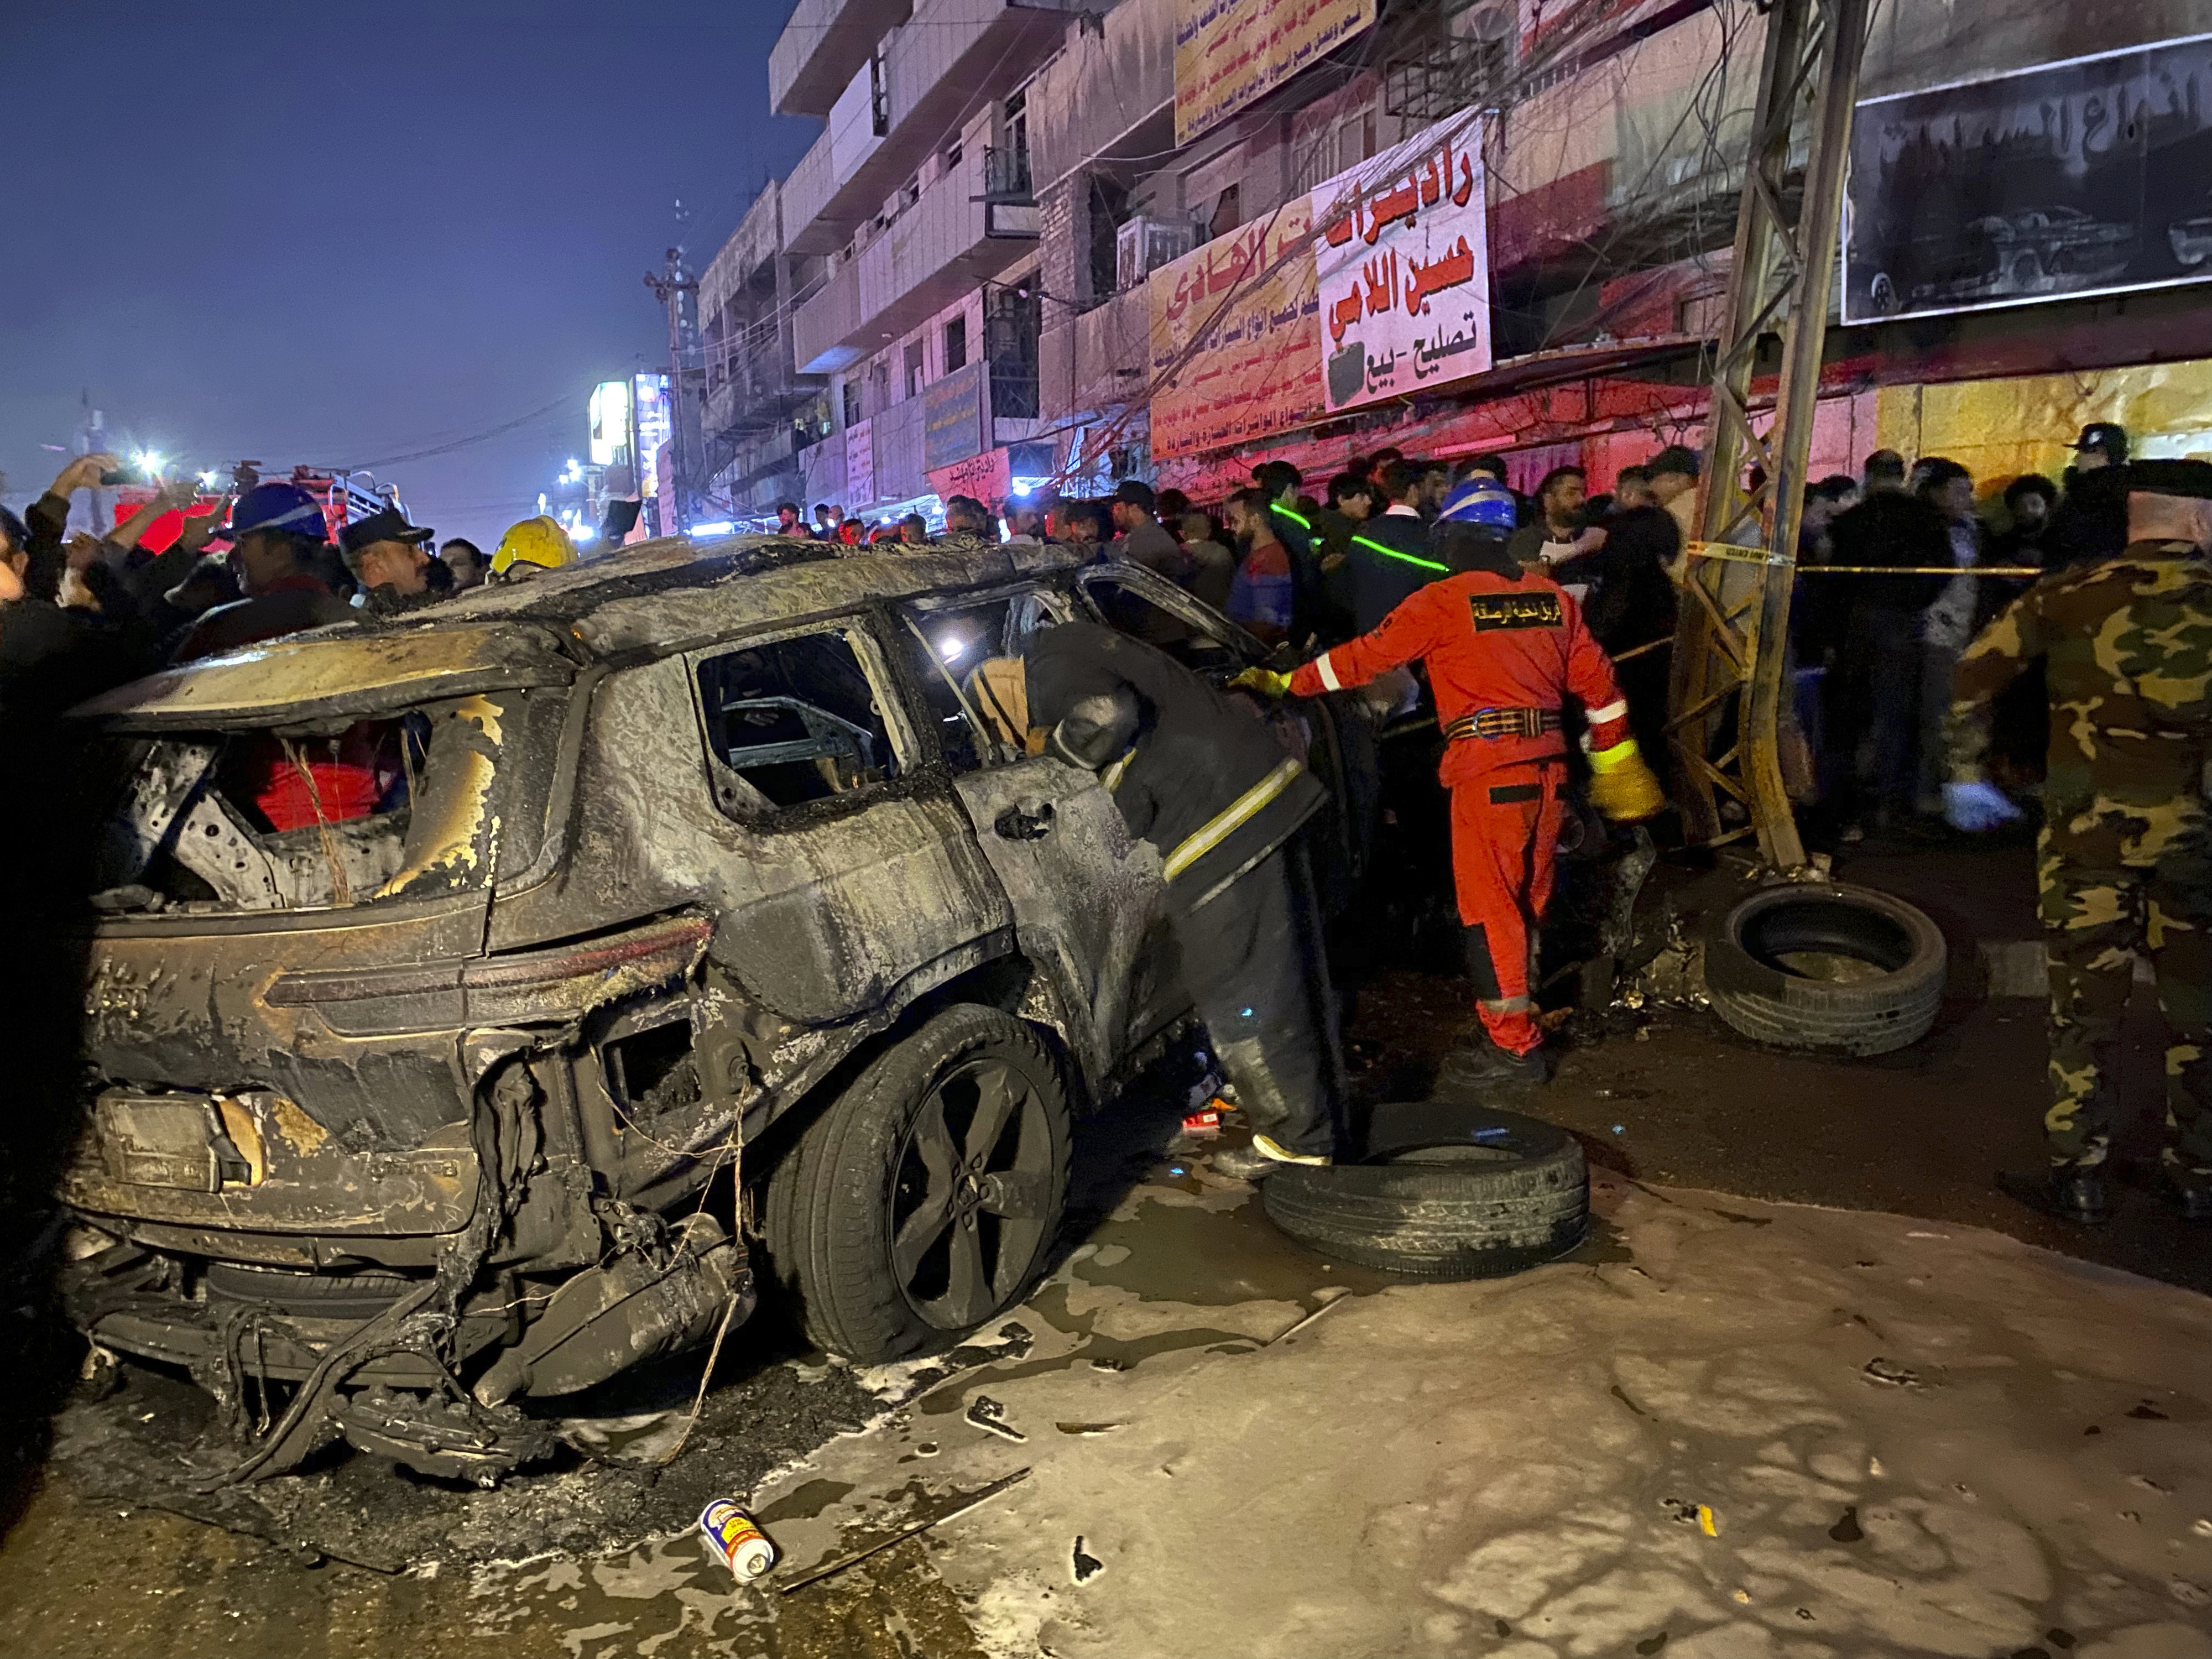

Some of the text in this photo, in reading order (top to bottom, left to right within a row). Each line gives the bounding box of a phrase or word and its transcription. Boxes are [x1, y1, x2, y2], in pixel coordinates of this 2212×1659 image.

[1329, 247, 1398, 353] اللامي
[1405, 235, 1474, 317] حسين
[1367, 347, 1394, 394] بيع
[1413, 311, 1477, 380] تصليح
